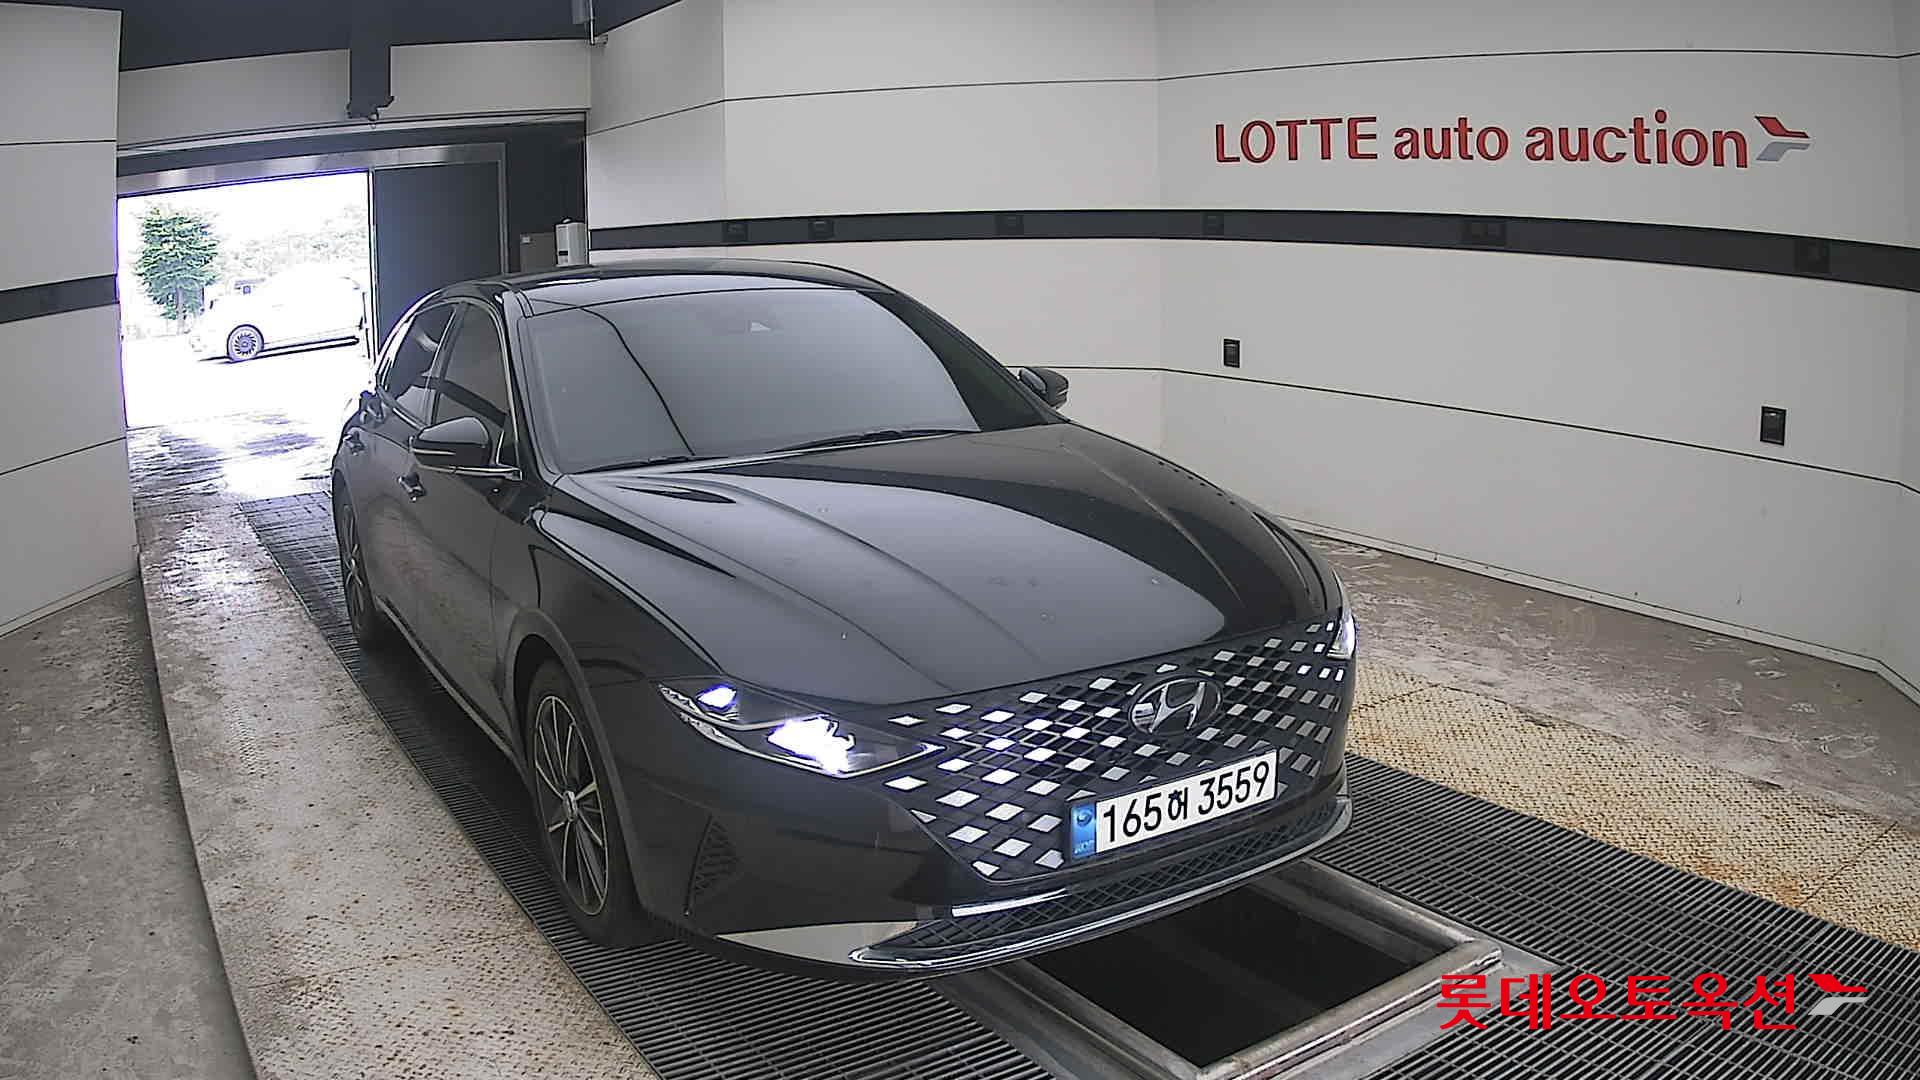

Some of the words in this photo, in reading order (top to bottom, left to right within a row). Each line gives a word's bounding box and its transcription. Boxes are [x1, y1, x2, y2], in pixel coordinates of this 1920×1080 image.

[1215, 116, 1378, 164] LOTTE
[1392, 116, 1511, 162] auto
[1524, 109, 1750, 169] auction
[1103, 787, 1189, 842] 165허
[1197, 760, 1271, 816] 3559
